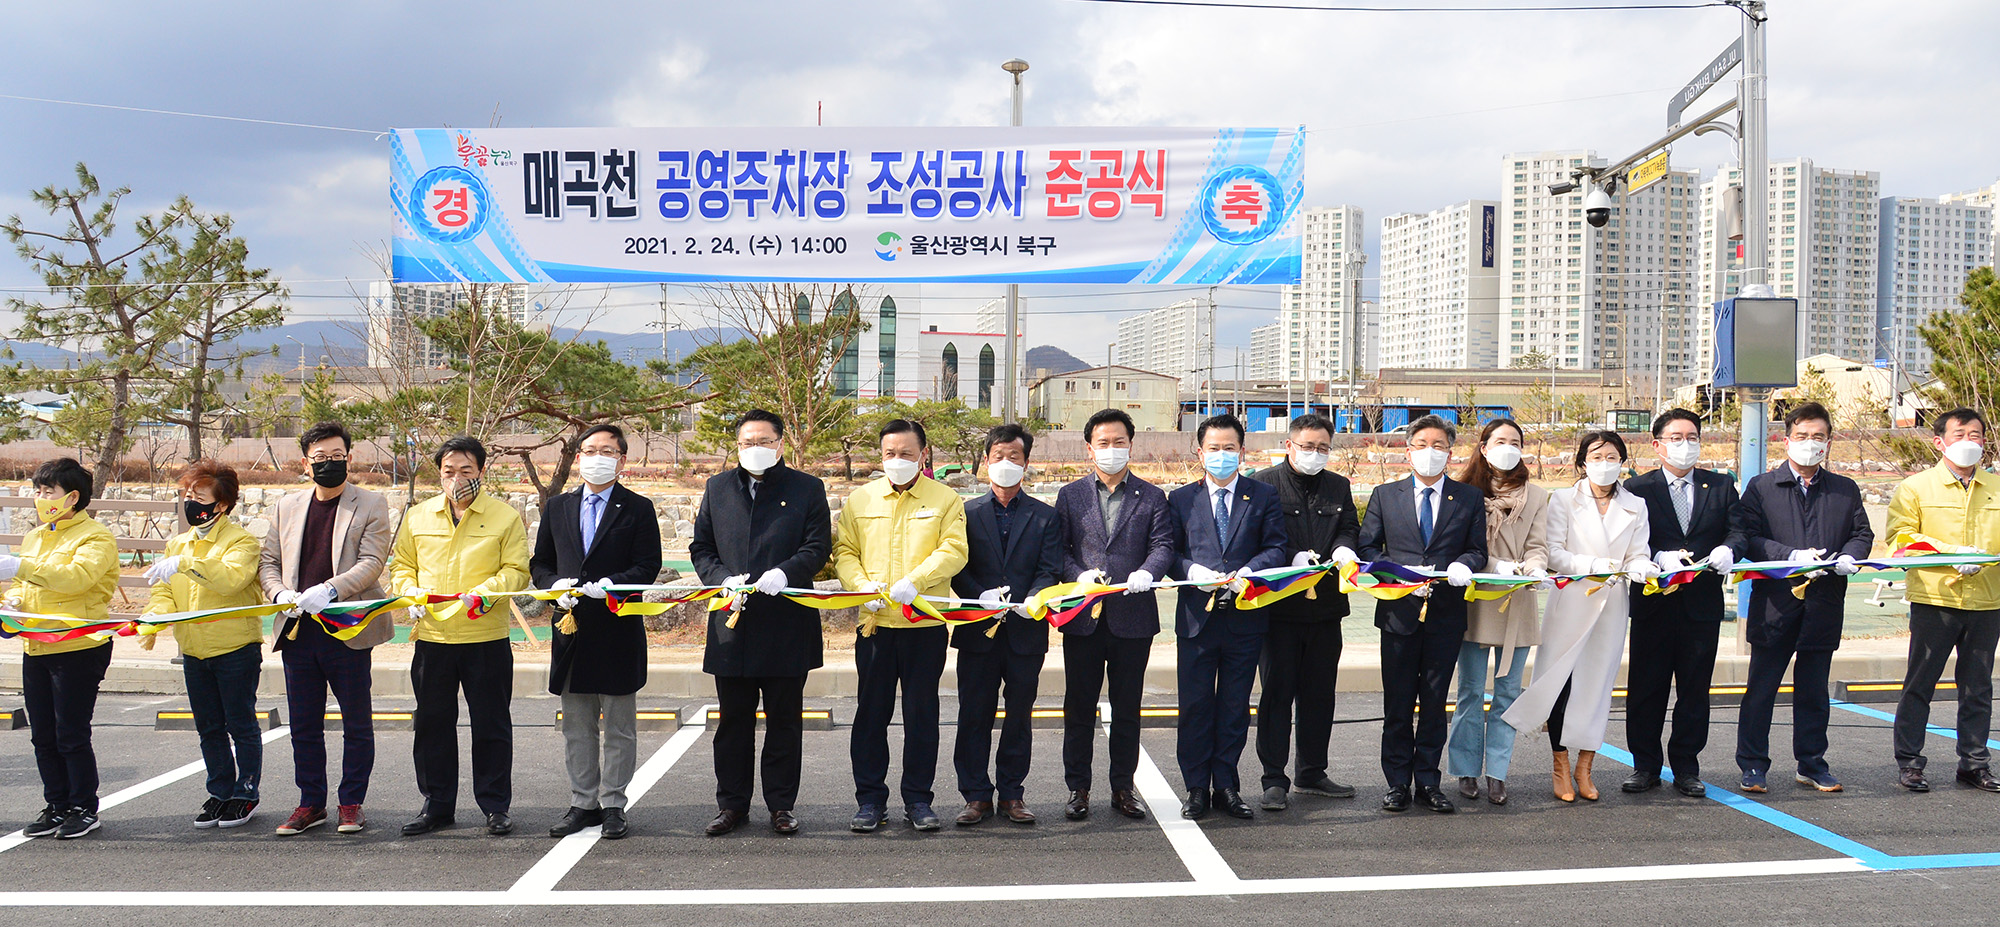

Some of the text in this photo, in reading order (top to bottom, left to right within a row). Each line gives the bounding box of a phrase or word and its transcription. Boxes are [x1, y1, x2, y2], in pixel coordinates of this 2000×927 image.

[523, 148, 1166, 219] 매곡천 공영주차장 조성공사 준공식
[433, 187, 469, 227] 경
[1221, 184, 1263, 226] 축
[624, 234, 847, 256] 2021. 2. 24. (수) 14:00
[909, 235, 1057, 256] 울산광역시 북구
